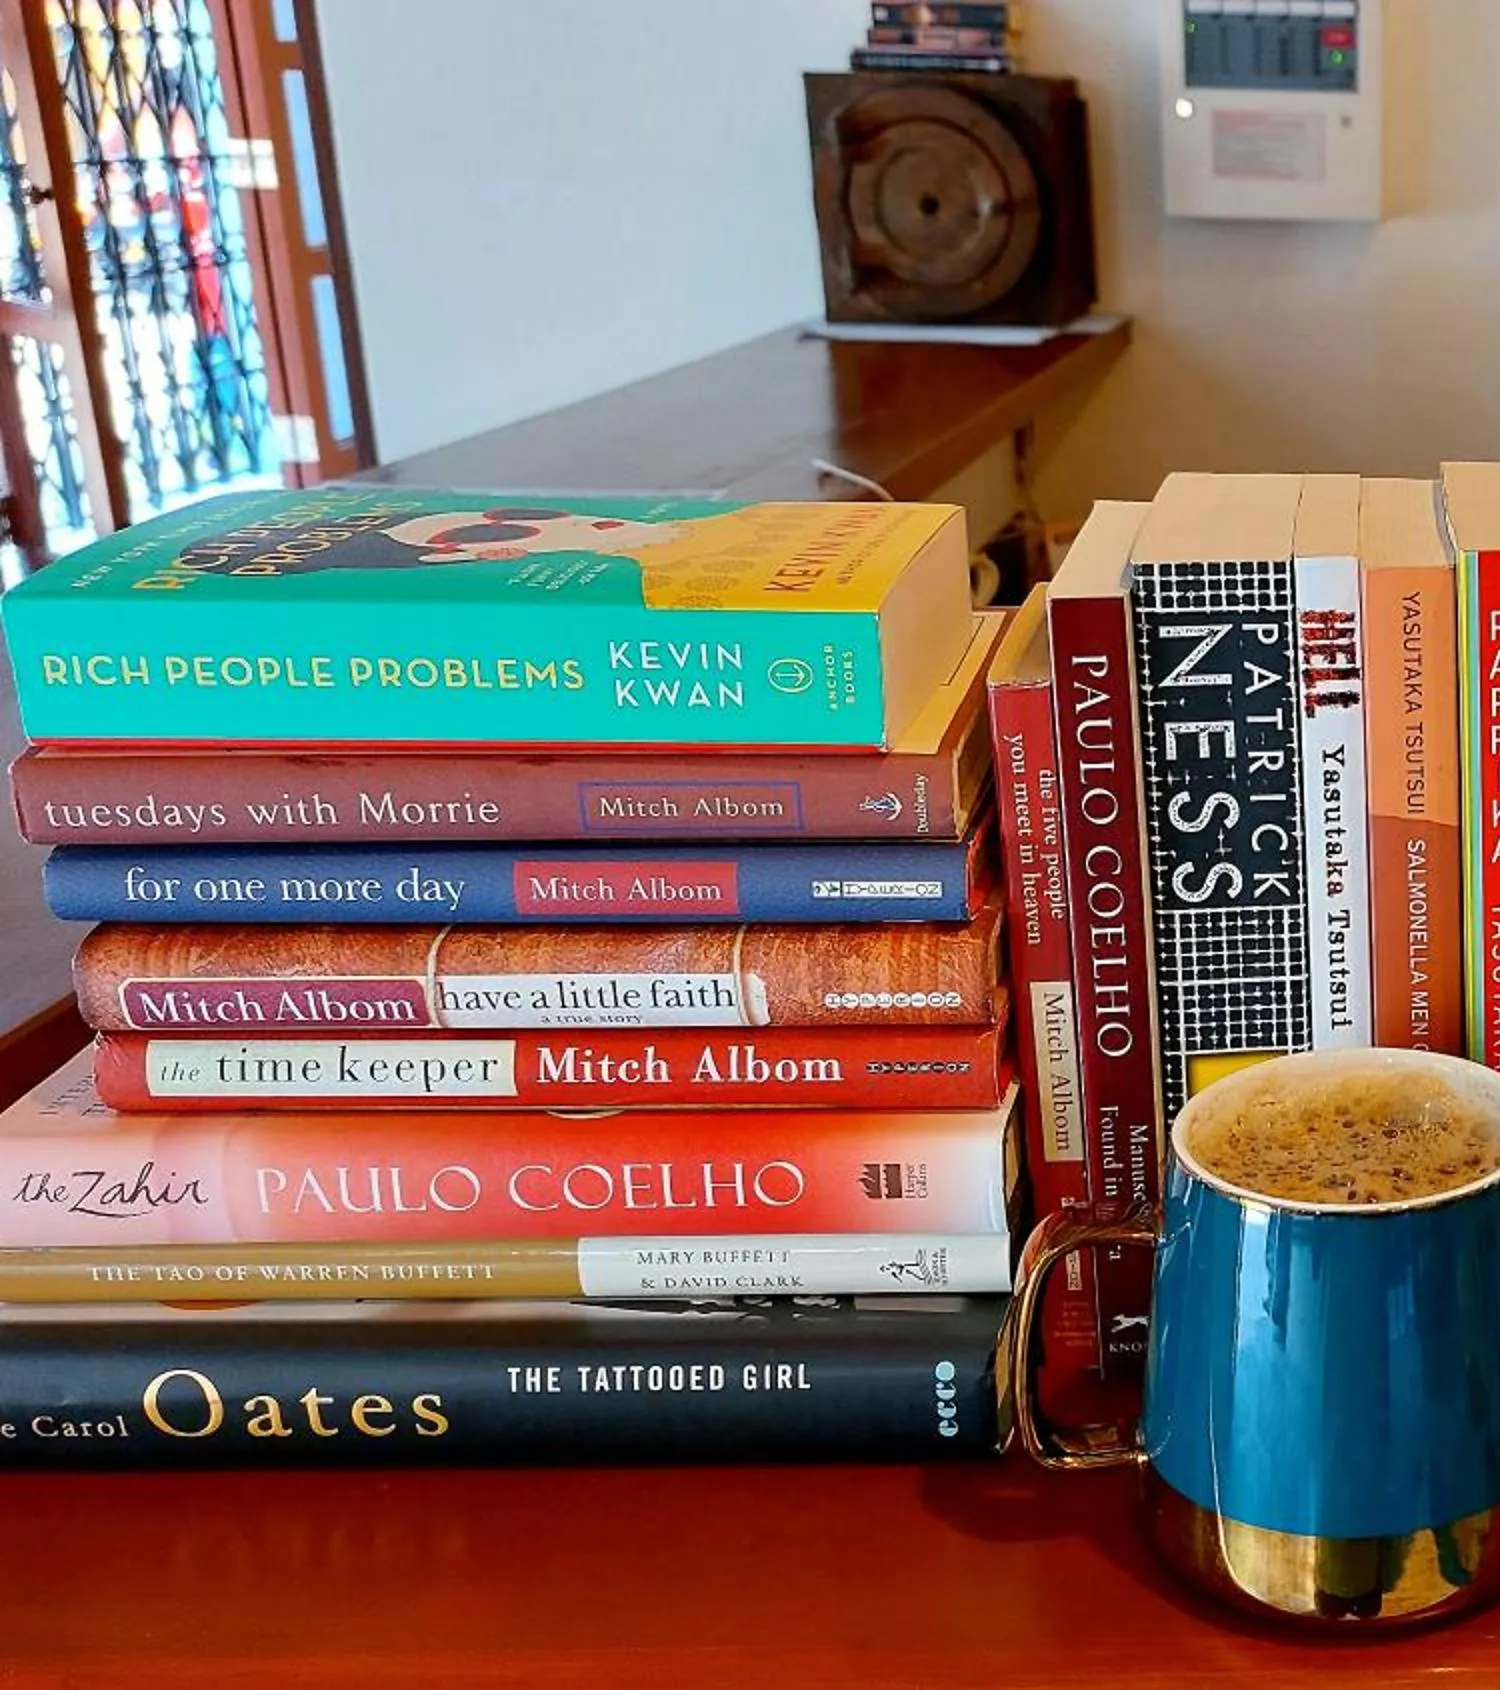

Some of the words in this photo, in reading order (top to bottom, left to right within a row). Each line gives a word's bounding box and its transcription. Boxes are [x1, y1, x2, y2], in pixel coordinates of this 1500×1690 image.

[42, 654, 151, 687] RICH
[166, 656, 336, 688] PEOPLE
[350, 657, 586, 691] PROBLEMS
[608, 640, 744, 671] KEVIN
[1300, 609, 1361, 719] HELL
[1401, 590, 1424, 715] YASUTAKA
[614, 679, 745, 708] KWAN
[1002, 733, 1025, 774] you
[1071, 654, 1119, 826] PAULO
[1240, 622, 1292, 899] PATRICK
[1038, 768, 1056, 799] the
[1158, 623, 1244, 904] NESS
[1404, 721, 1426, 815] TSUTSUI
[44, 795, 227, 828] tuesdays
[247, 794, 338, 826] with
[359, 793, 500, 825] Morrie
[599, 796, 680, 819] Mitch
[693, 796, 785, 819] Albom
[1012, 782, 1033, 838] meet
[1040, 805, 1061, 847] five
[1321, 743, 1345, 898] Yasutaka
[1019, 840, 1039, 865] in
[124, 867, 181, 902] for
[193, 878, 266, 902] one
[280, 876, 384, 902] more
[395, 867, 465, 912] day
[529, 876, 618, 902] Mitch
[627, 876, 722, 902] Albom
[1040, 849, 1067, 921] people
[1023, 871, 1042, 946] heaven
[1406, 838, 1430, 986] SALMONELLA
[1084, 844, 1133, 1057] COELHO
[1326, 908, 1353, 1032] Tsutsui
[139, 990, 268, 1024] Mitch
[273, 990, 417, 1022] Albom
[438, 982, 521, 1013] have
[530, 990, 552, 1011] a
[555, 979, 645, 1010] little
[650, 978, 736, 1009] faith
[825, 992, 961, 1008] HYPERION
[1409, 993, 1430, 1036] MEN
[540, 1015, 553, 1025] a
[557, 1015, 596, 1025] true
[599, 1014, 643, 1026] story
[1042, 991, 1069, 1063] Mitch
[160, 1061, 201, 1083] the
[216, 1047, 323, 1084] time
[338, 1045, 499, 1093] keeper
[536, 1046, 671, 1085] Mitch
[690, 1045, 845, 1083] Albom
[1050, 1072, 1073, 1152] Albom
[1099, 1104, 1124, 1170] Found
[13, 1172, 70, 1203] the
[68, 1161, 209, 1218] Zahir
[255, 1164, 482, 1214] PAULO
[507, 1160, 806, 1213] COELHO
[1103, 1173, 1119, 1197] in
[89, 1265, 141, 1282] THE
[153, 1264, 203, 1281] TAO
[215, 1264, 248, 1281] OF
[259, 1264, 370, 1281] WARREN
[381, 1263, 496, 1281] BUFFETT
[636, 1251, 695, 1265] MARY
[702, 1250, 791, 1265] BUFFETT
[640, 1278, 655, 1289] &
[664, 1277, 728, 1289] DAVID
[735, 1276, 804, 1288] CLARK
[507, 1366, 561, 1393] THE
[577, 1364, 725, 1392] TATTOOED
[741, 1362, 812, 1390] GIRL
[934, 1359, 960, 1438] ecco
[31, 1414, 129, 1439] Carol
[142, 1368, 450, 1439] Oates
